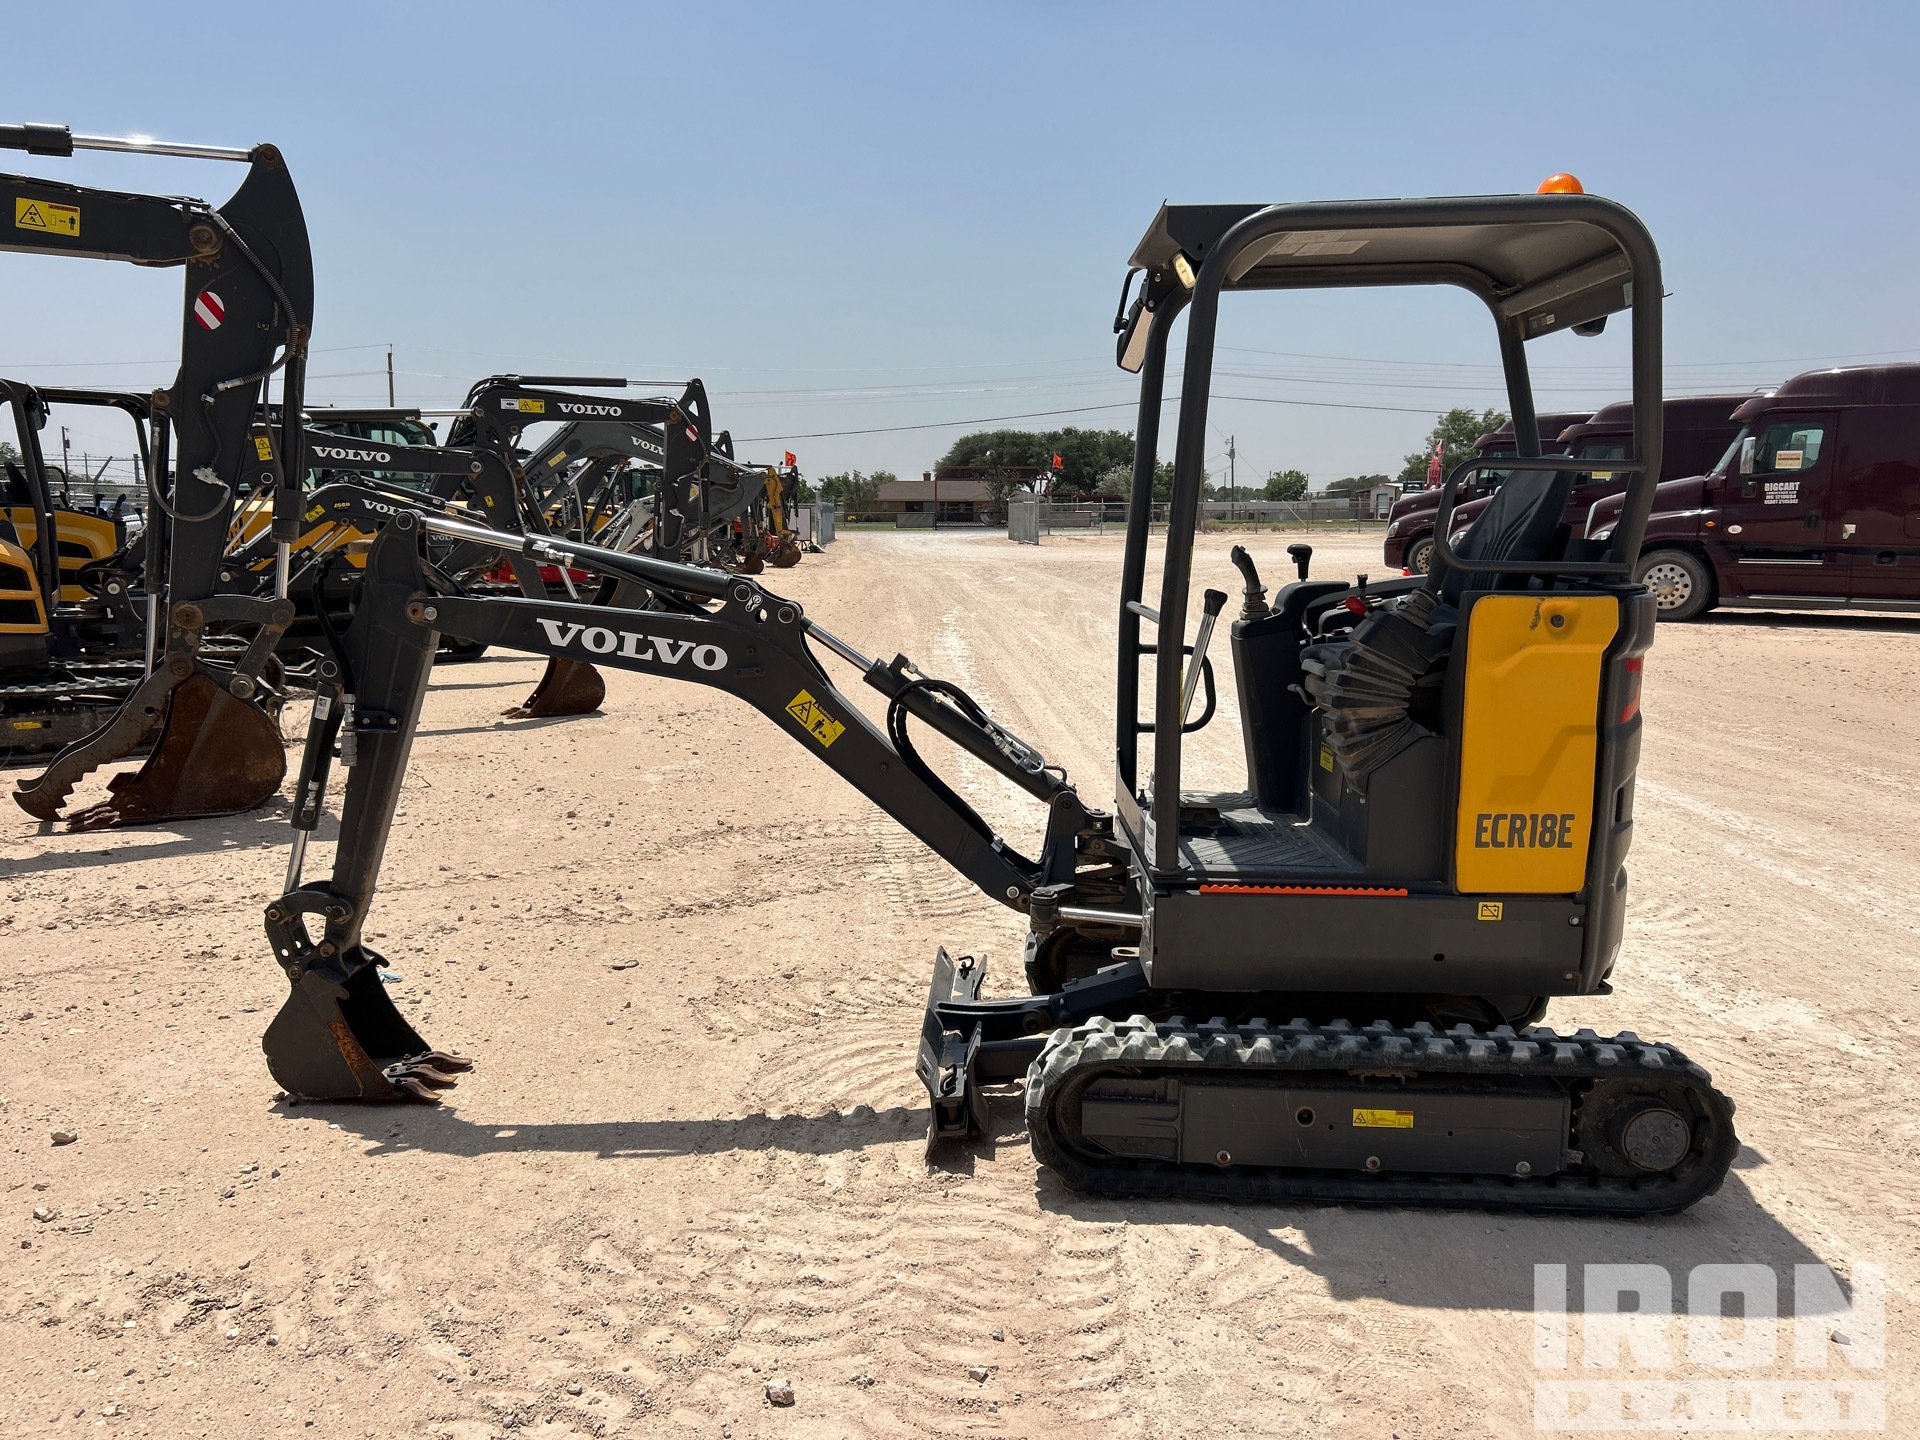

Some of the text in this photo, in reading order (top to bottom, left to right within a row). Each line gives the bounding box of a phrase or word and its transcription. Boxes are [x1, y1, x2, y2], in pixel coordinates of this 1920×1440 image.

[557, 402, 622, 416] VOLVO
[312, 446, 391, 463] VOLVO
[631, 436, 664, 456] VOLV
[1764, 482, 1800, 491] BIGCART
[361, 499, 397, 516] VOL
[536, 617, 728, 671] VOLVO
[1474, 813, 1576, 849] ECR18E
